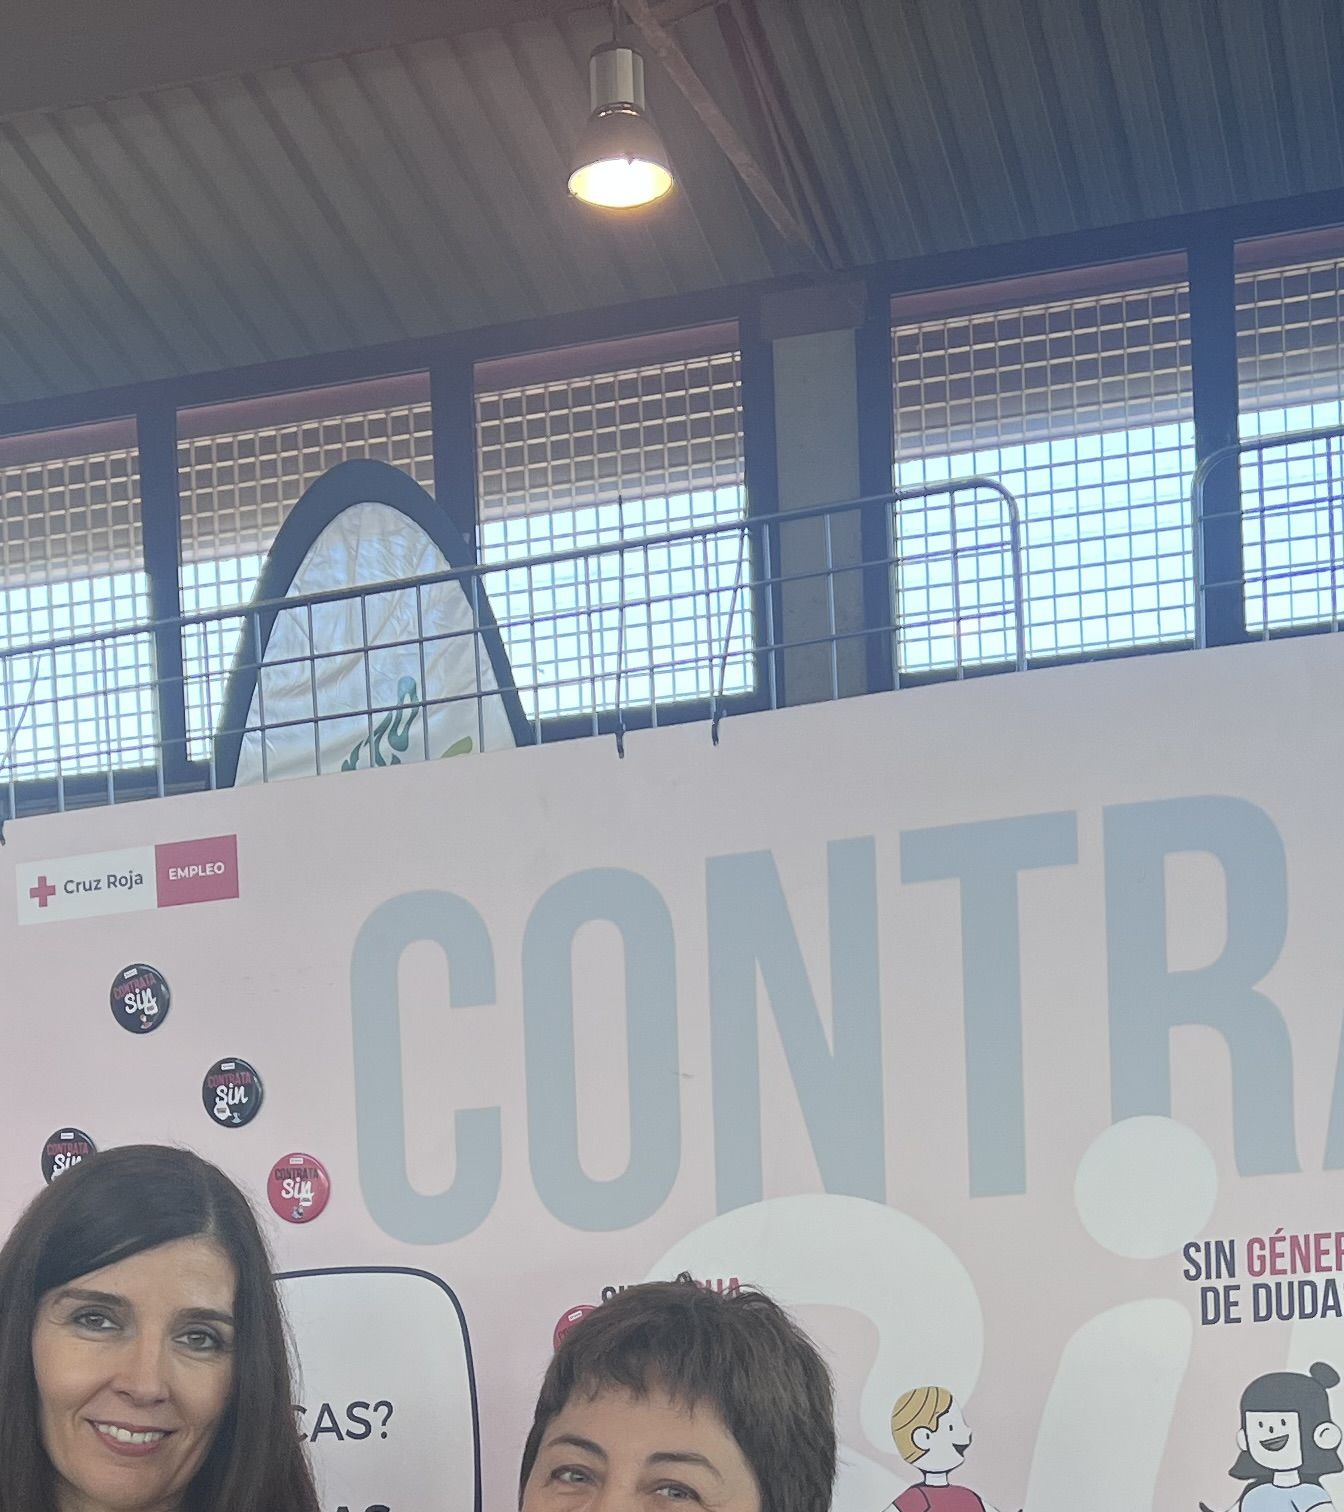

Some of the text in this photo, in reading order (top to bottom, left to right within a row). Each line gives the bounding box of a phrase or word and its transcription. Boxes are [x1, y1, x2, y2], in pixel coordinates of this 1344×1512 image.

[64, 870, 144, 894] Cruz Roja
[168, 862, 226, 880] EMPLEO
[1183, 1239, 1236, 1281] SIN
[1201, 1285, 1241, 1326] DE
